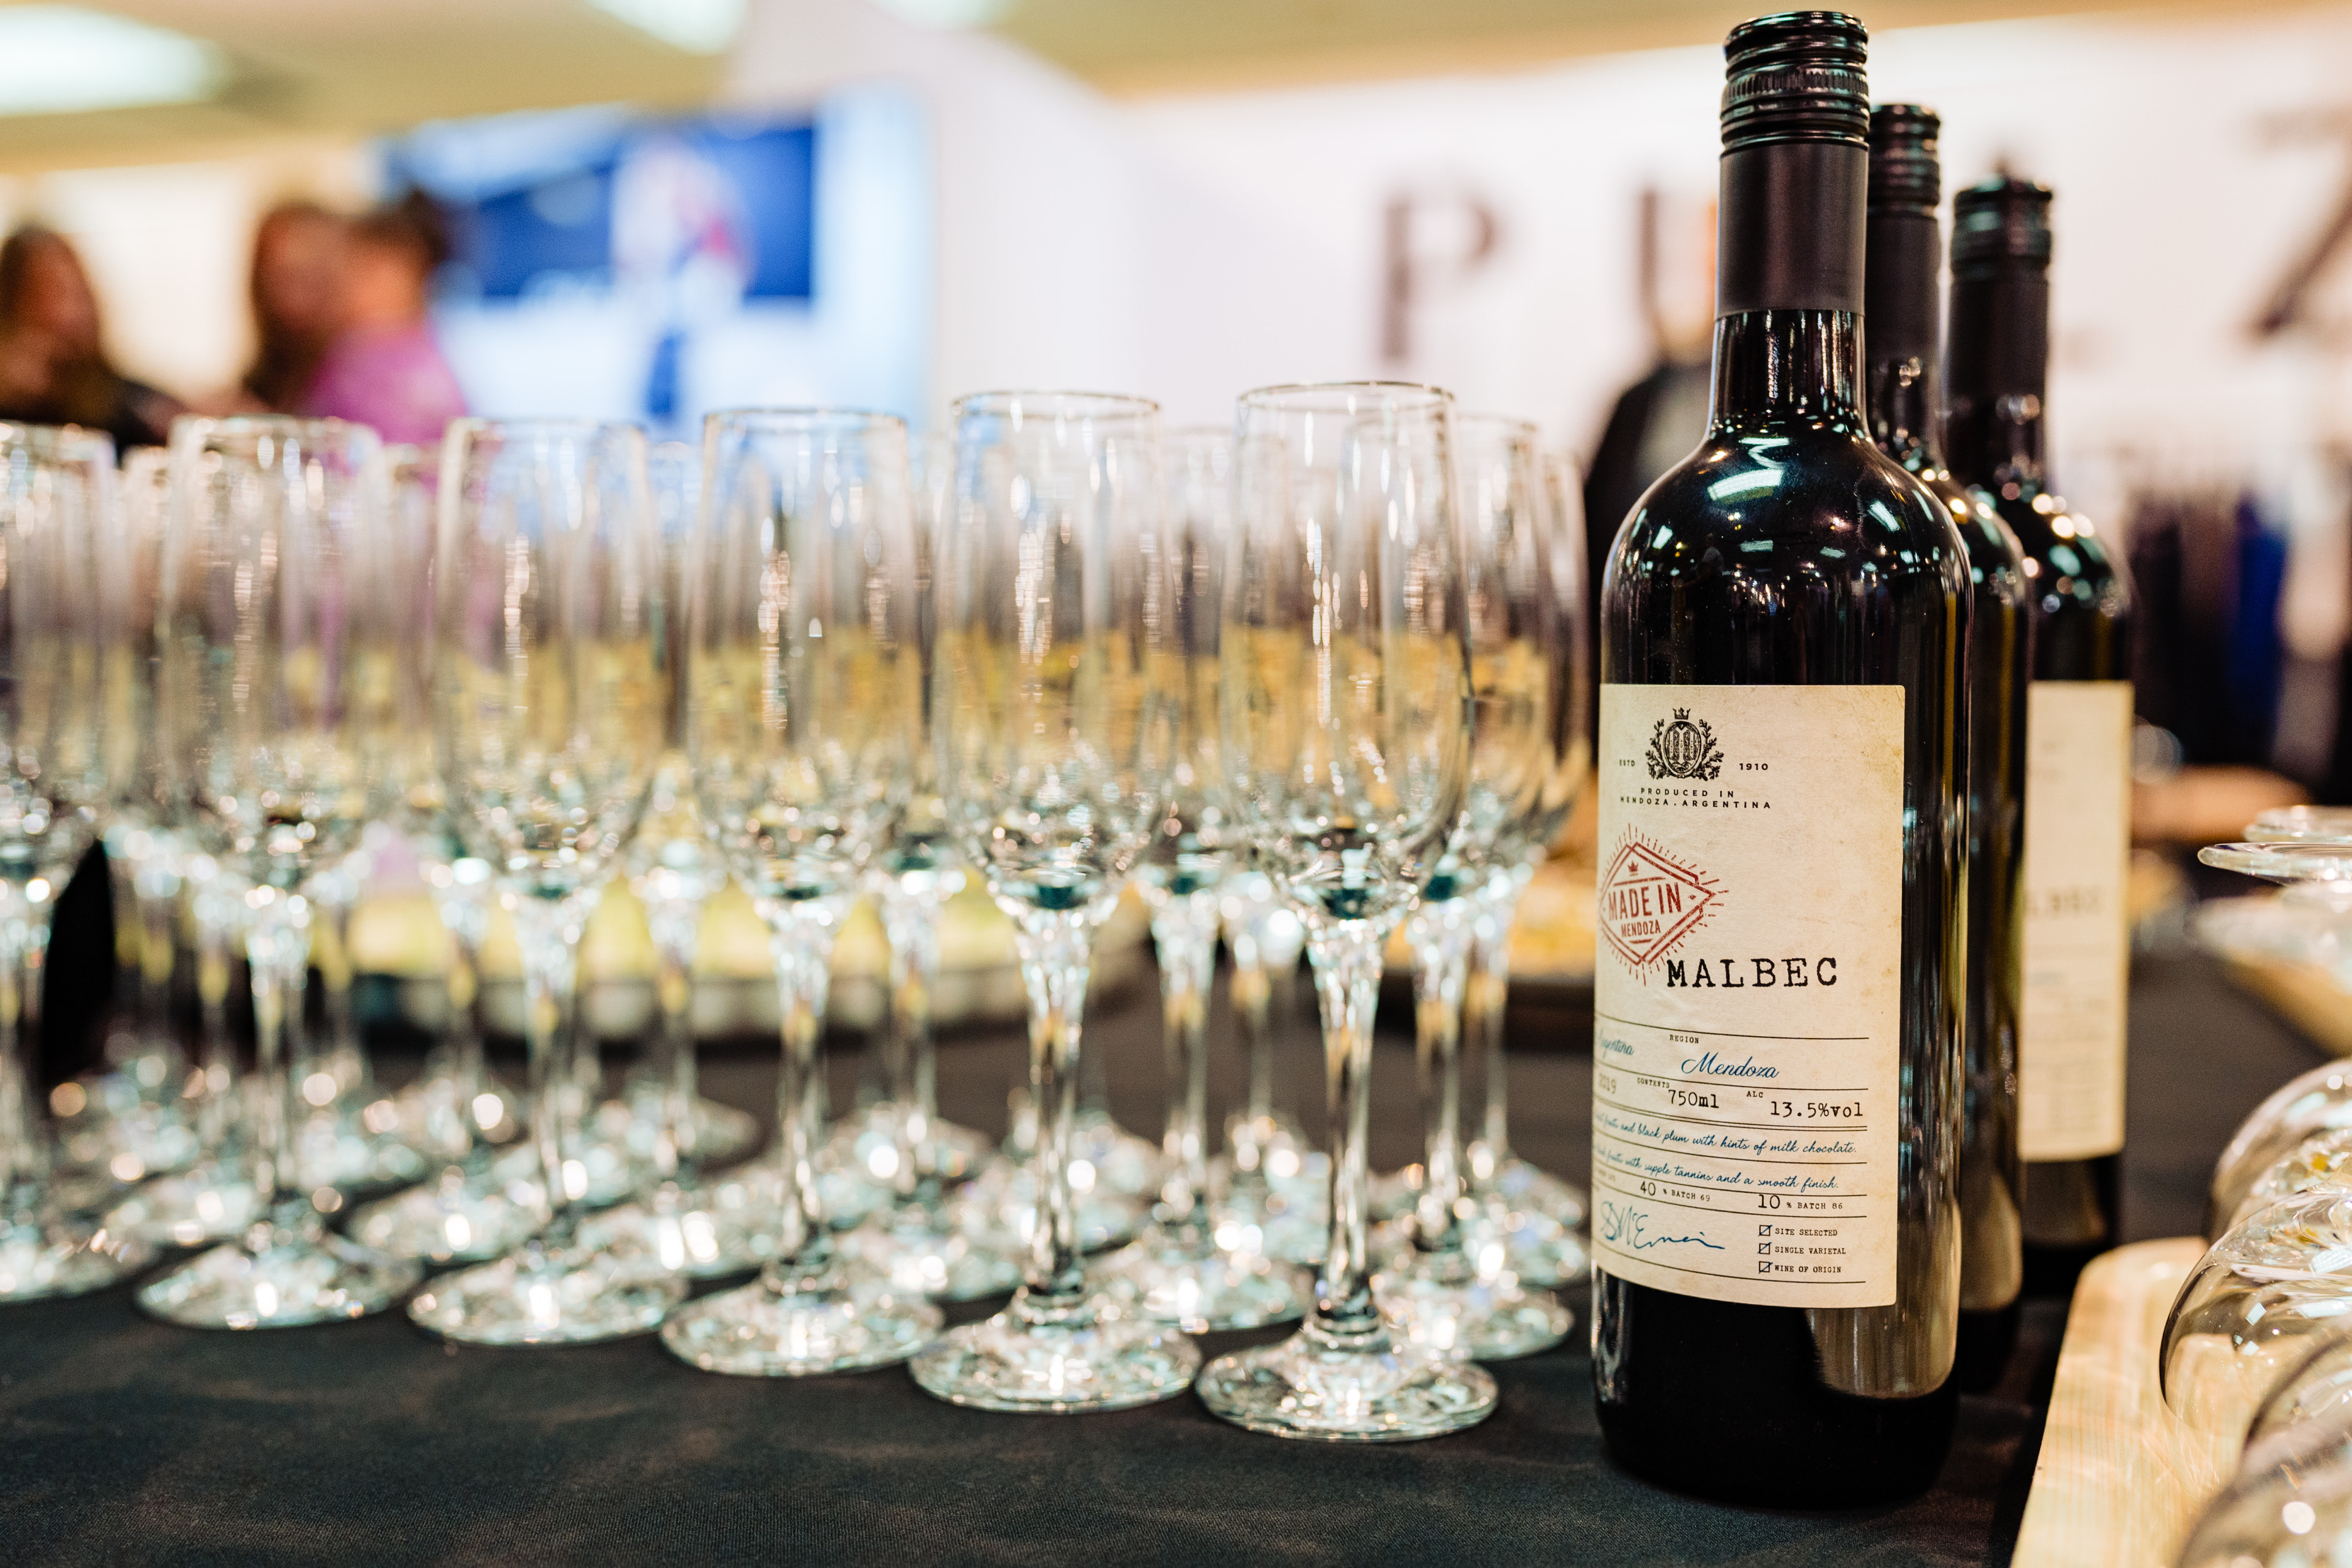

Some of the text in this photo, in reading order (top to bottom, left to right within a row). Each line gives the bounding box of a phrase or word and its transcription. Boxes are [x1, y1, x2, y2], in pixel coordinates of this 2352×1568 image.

[1619, 759, 1769, 771] ESTD 1910
[1641, 787, 1708, 797] PRODUCED
[1608, 882, 1682, 921] MADE IN
[1621, 919, 1661, 937] MENDOZA
[1666, 957, 1837, 988] MALBEC
[1669, 1034, 1699, 1044] REGION
[1681, 1051, 1780, 1078] Mendoza
[1637, 1077, 1670, 1088] CONTENTS
[1668, 1089, 1720, 1109] 750ml
[1770, 1101, 1863, 1119] 13.5%vol
[1638, 1123, 1662, 1138] black
[1662, 1129, 1689, 1144] plum
[1692, 1134, 1717, 1147] with
[1720, 1135, 1750, 1150] hints
[1753, 1139, 1768, 1156] of
[1770, 1140, 1800, 1152] milk
[1802, 1140, 1857, 1154] chocolate.
[1625, 1157, 1642, 1168] with
[1644, 1163, 1671, 1177] supple
[1674, 1165, 1713, 1180] tannins
[1716, 1171, 1742, 1184] and
[1757, 1175, 1800, 1187] smooth
[1800, 1176, 1838, 1193] finish.
[1640, 1181, 1656, 1196] 40
[1671, 1189, 1696, 1200] BATCH
[1700, 1194, 1710, 1202] 69
[1758, 1194, 1781, 1209] 10
[1797, 1202, 1826, 1210] BATCH
[1774, 1227, 1795, 1236] SITE
[1774, 1246, 1804, 1254] SINGLE
[1774, 1264, 1794, 1273] WINE
